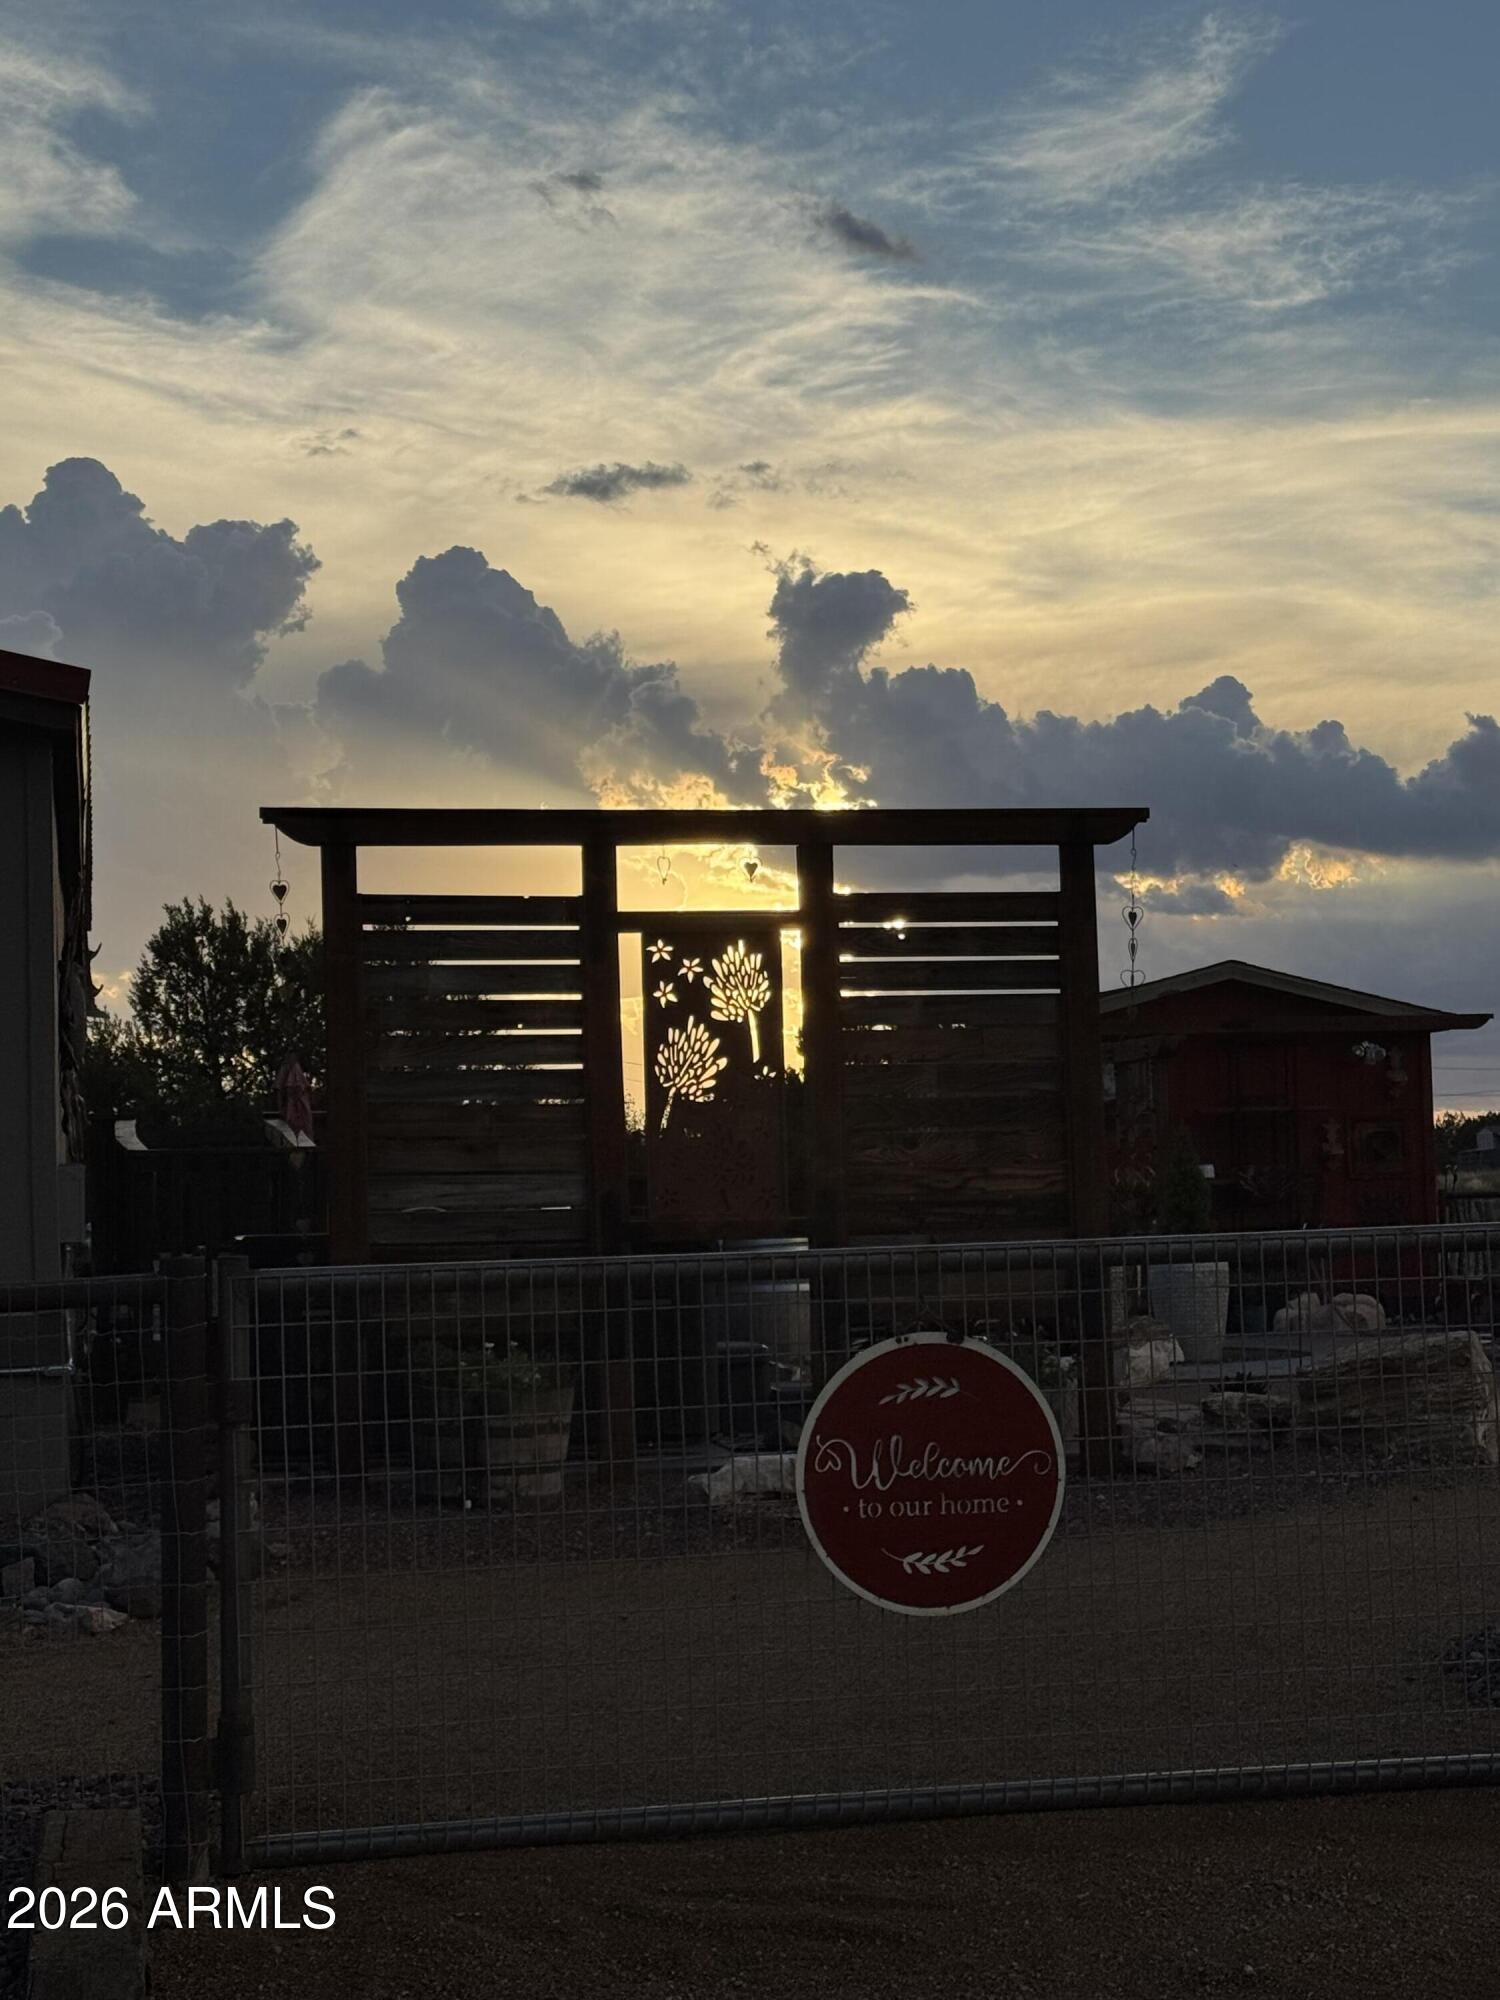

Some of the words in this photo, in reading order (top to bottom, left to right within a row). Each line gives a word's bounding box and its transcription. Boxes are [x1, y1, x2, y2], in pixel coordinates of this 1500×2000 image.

[815, 1434, 1051, 1491] Welcome
[858, 1498, 883, 1518] to
[890, 1499, 933, 1517] our
[939, 1493, 1010, 1515] home
